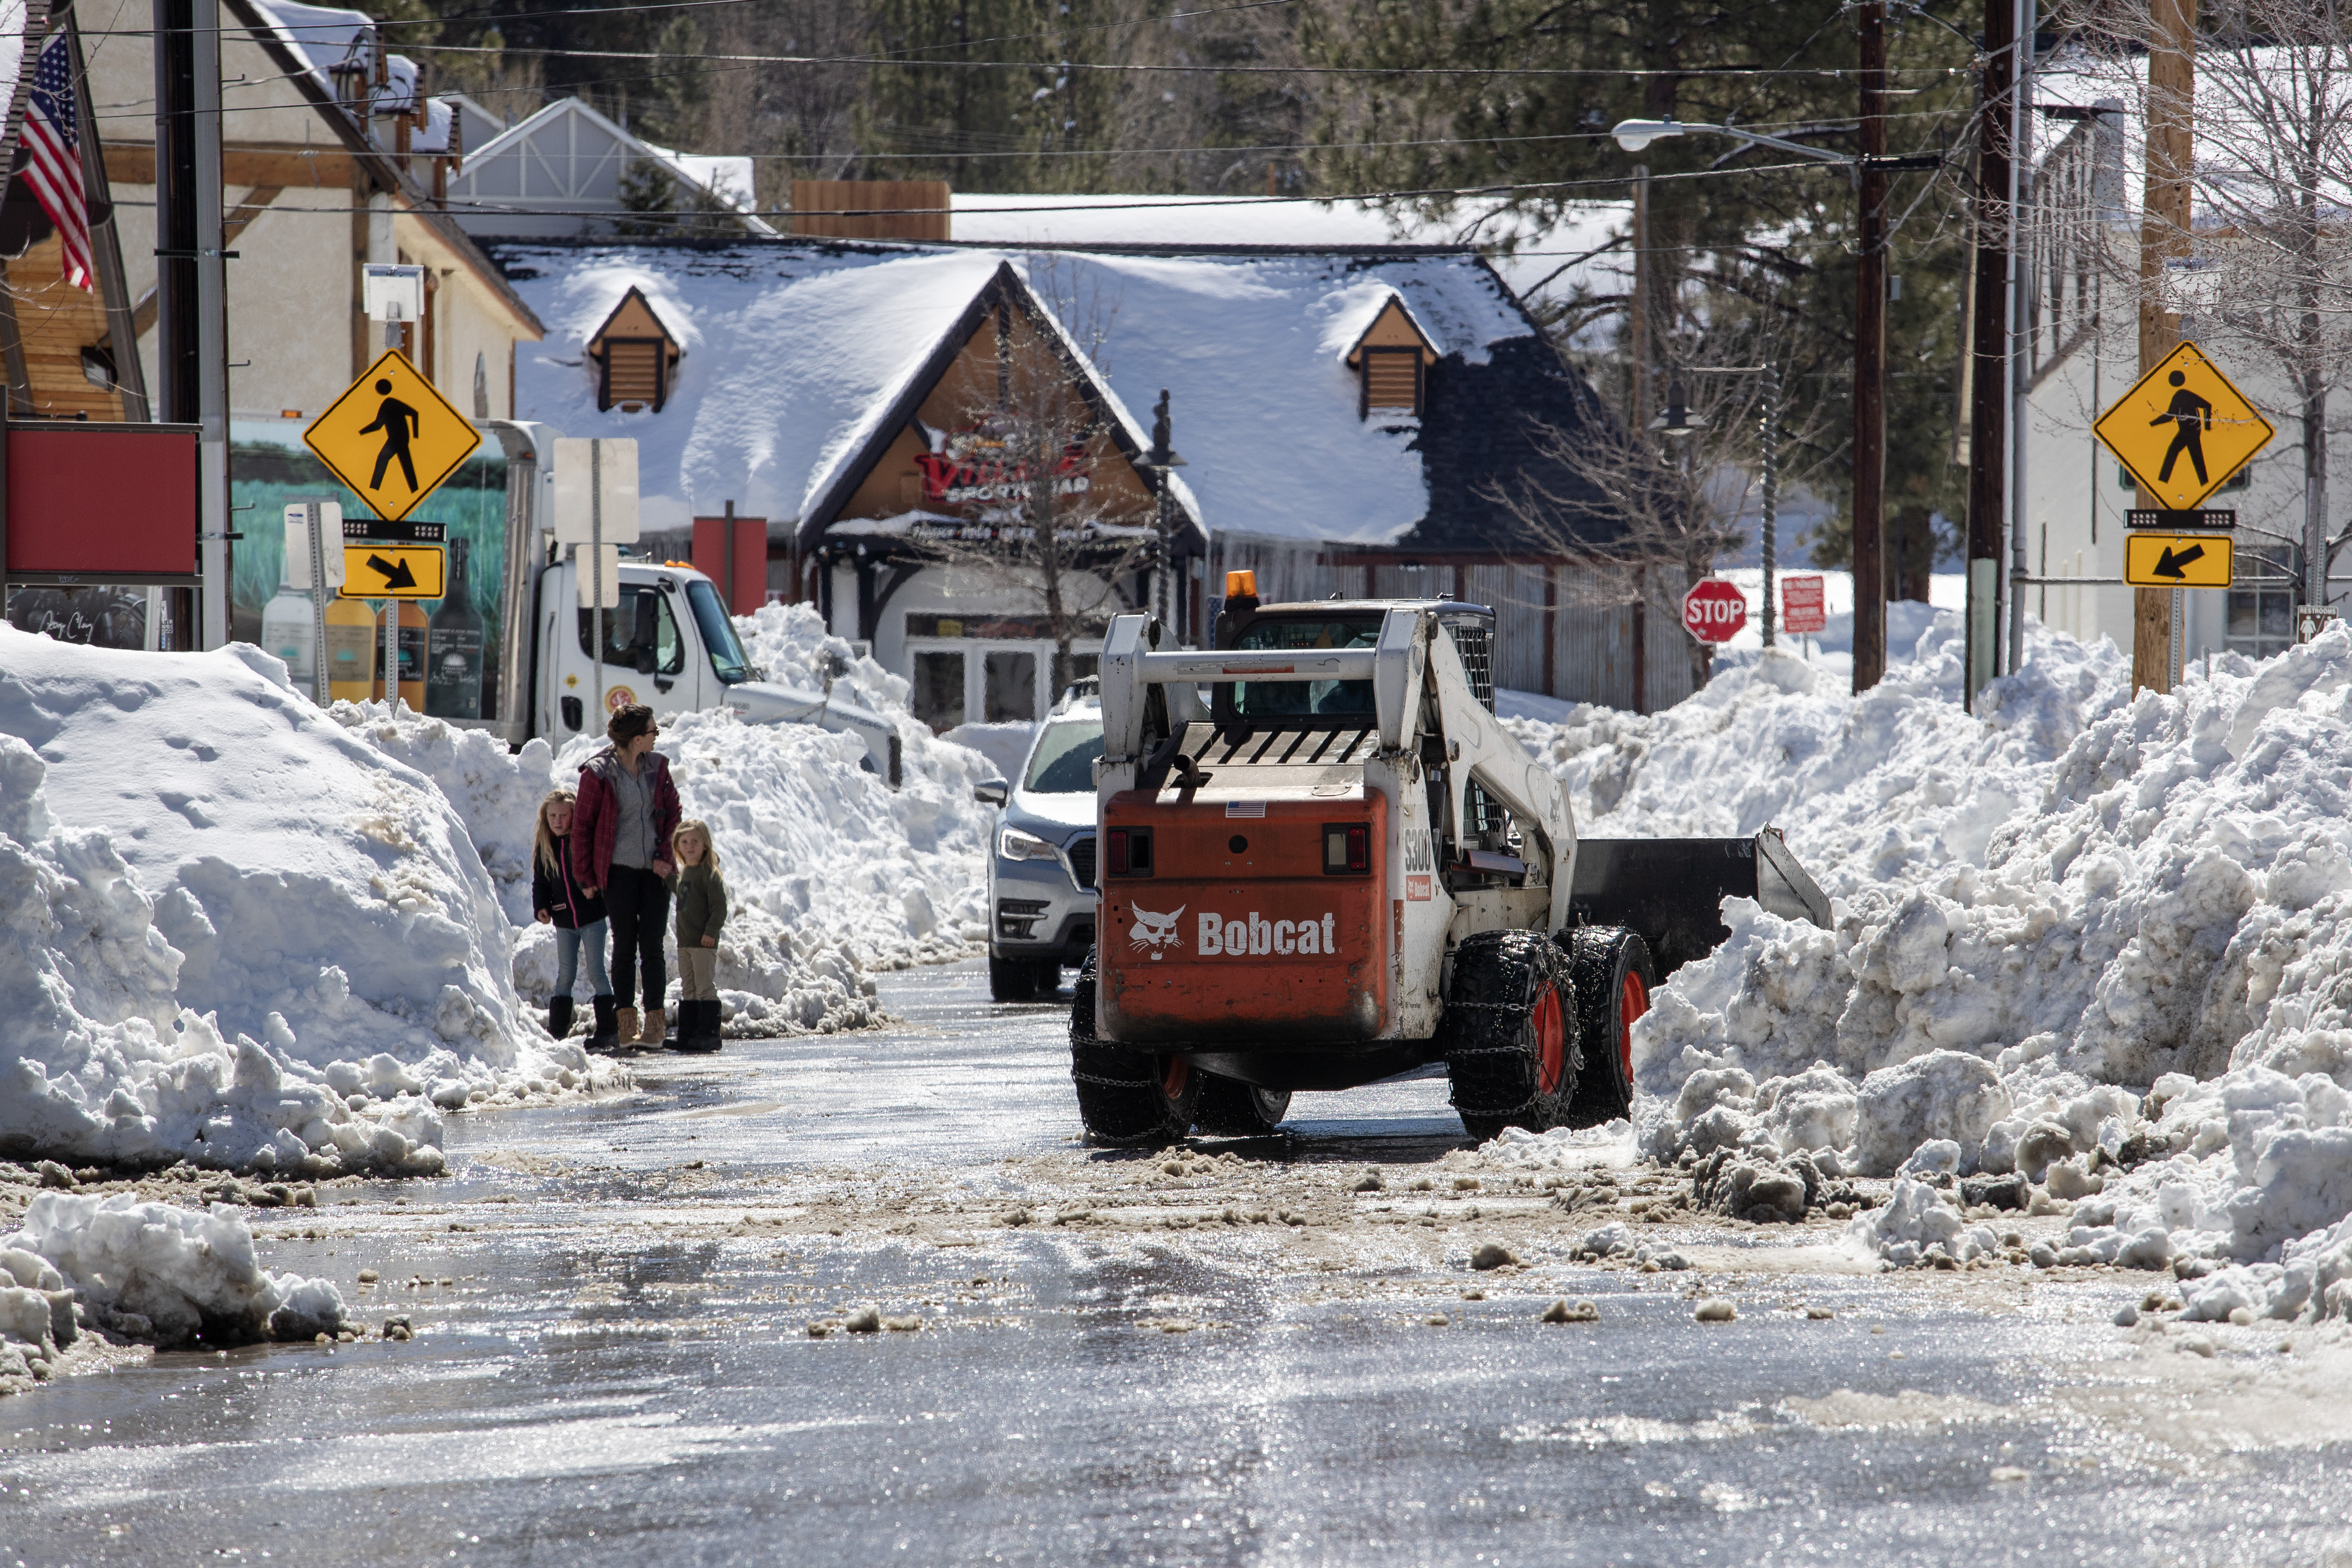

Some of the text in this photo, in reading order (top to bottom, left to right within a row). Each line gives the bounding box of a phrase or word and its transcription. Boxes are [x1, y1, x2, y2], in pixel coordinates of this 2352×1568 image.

[913, 447, 1090, 500] VILLAE
[1687, 598, 1744, 623] STOP
[1405, 828, 1431, 872] S300
[1414, 881, 1429, 897] Bobcat
[1198, 911, 1335, 956] Bobcat
